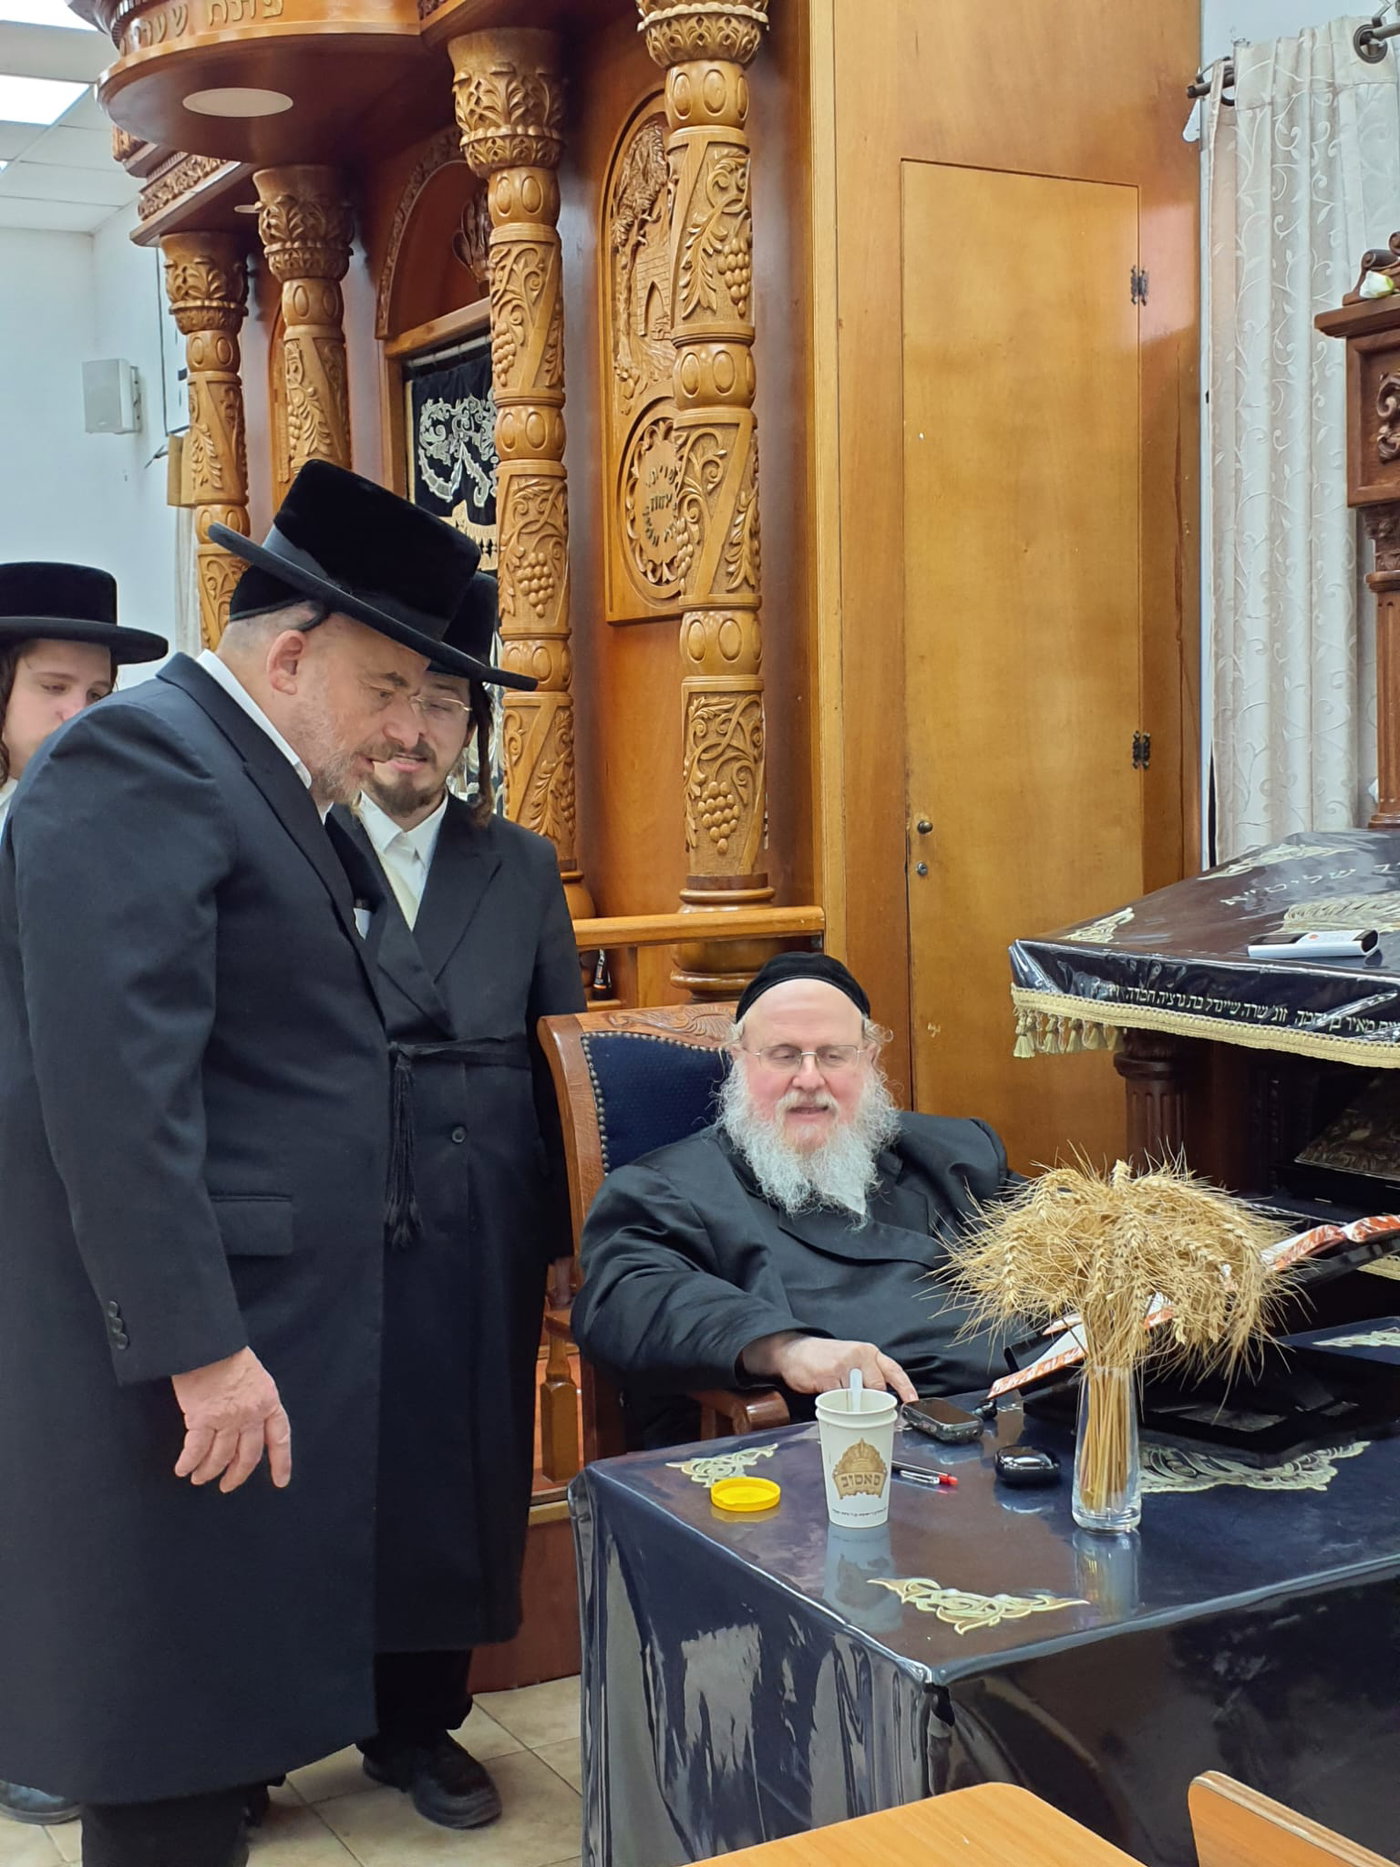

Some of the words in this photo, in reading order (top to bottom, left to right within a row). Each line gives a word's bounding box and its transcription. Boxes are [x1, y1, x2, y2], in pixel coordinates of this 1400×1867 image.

[1186, 995, 1204, 1010] בת
[1240, 1003, 1269, 1018] שרה
[1345, 1016, 1375, 1032] מאיר
